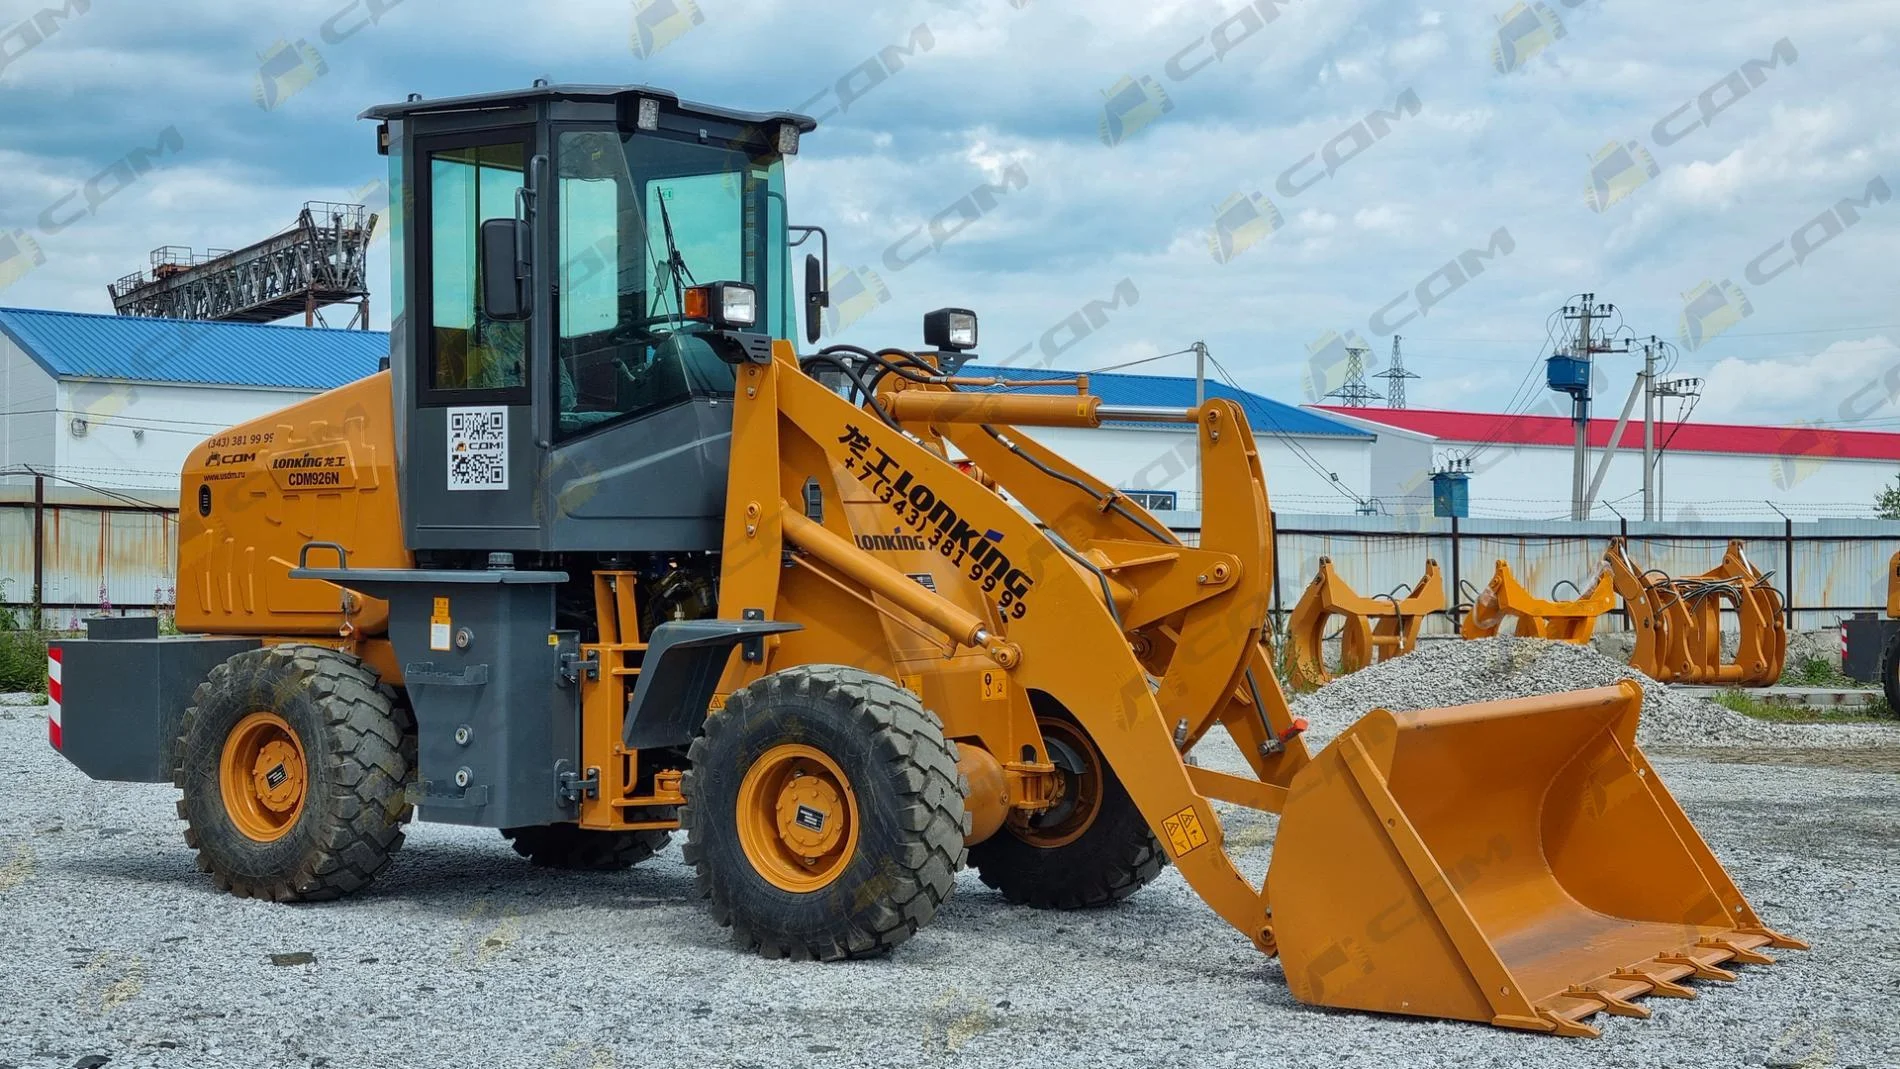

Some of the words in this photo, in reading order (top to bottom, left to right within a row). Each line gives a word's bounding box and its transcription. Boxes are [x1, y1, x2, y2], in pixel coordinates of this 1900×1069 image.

[208, 438, 229, 450] (343)
[232, 435, 247, 446] 381
[250, 433, 261, 445] 99
[323, 456, 346, 468] 龙工
[203, 470, 246, 482] www.usdm.ru
[288, 471, 340, 486] CDM926N
[927, 529, 967, 569] 381
[968, 563, 997, 593] 99
[998, 590, 1027, 620] 99
